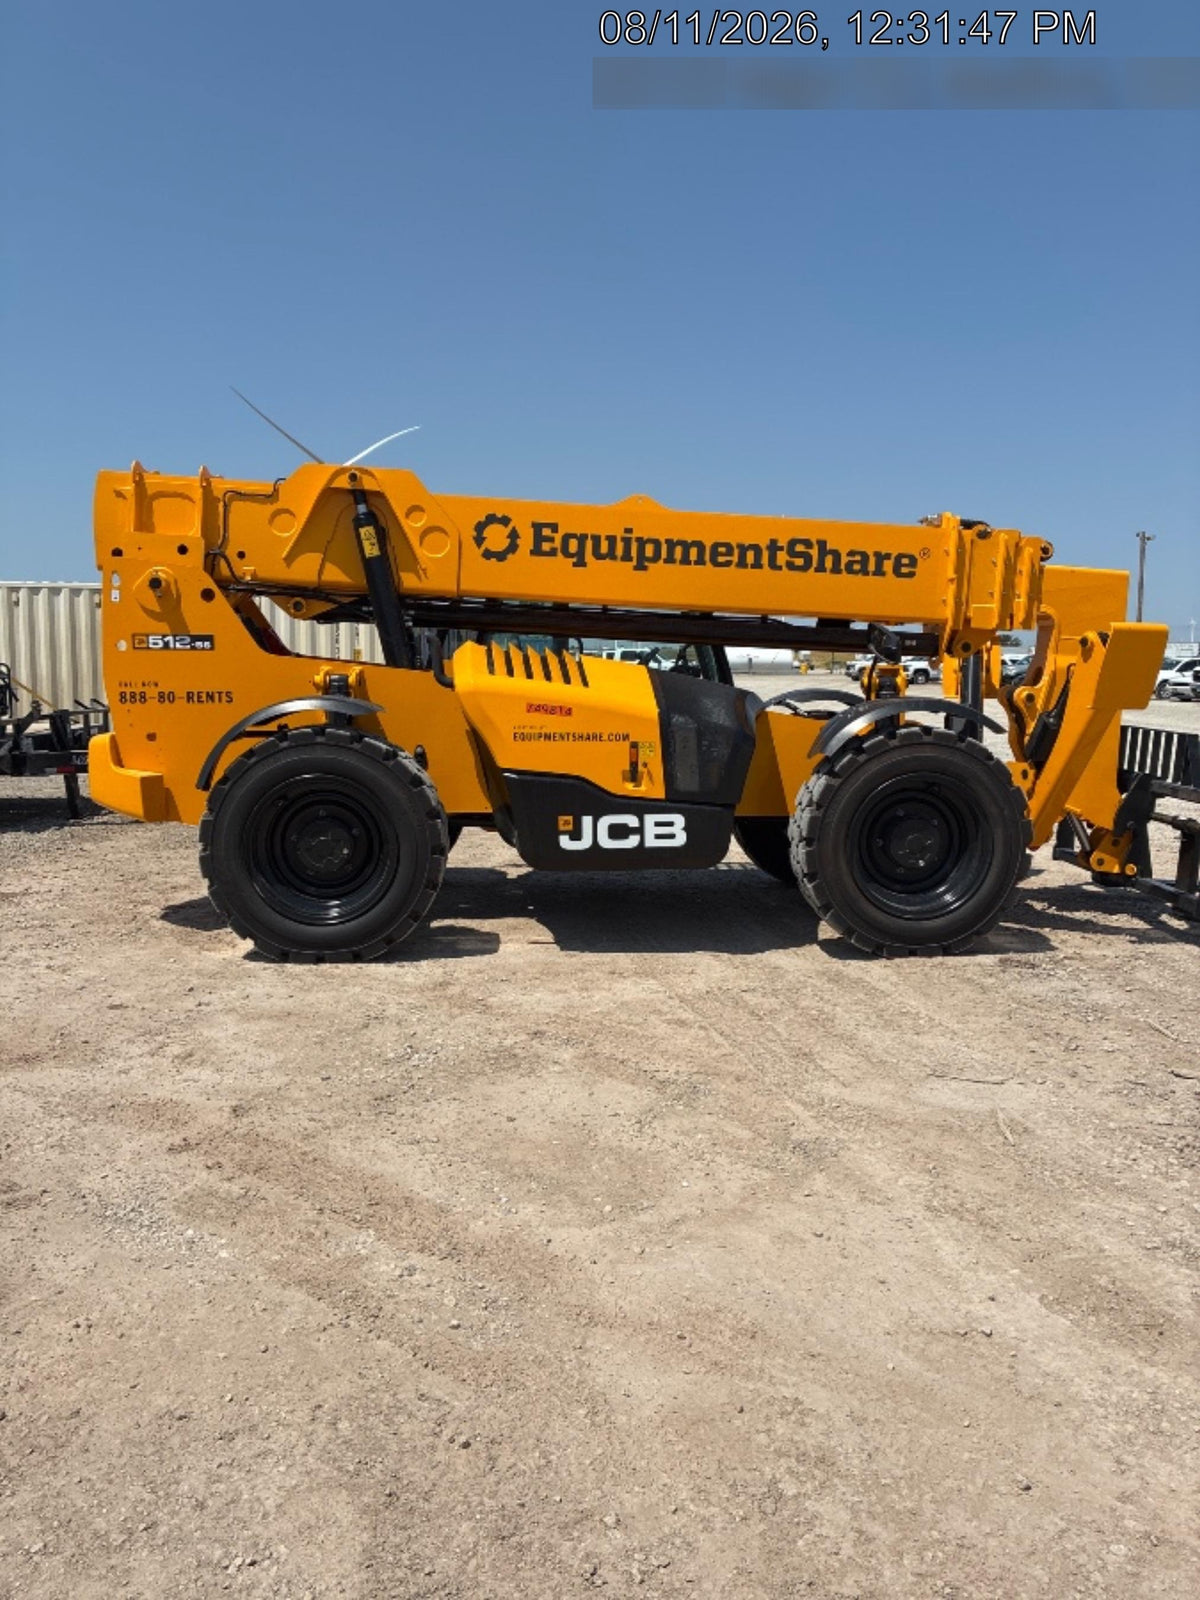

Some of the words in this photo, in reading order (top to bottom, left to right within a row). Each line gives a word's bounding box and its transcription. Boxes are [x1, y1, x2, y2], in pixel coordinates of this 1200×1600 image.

[119, 691, 233, 704] 888-80-RENTS
[513, 732, 630, 742] EQUIPMENTSHARE.COM
[558, 813, 687, 851] JCB
